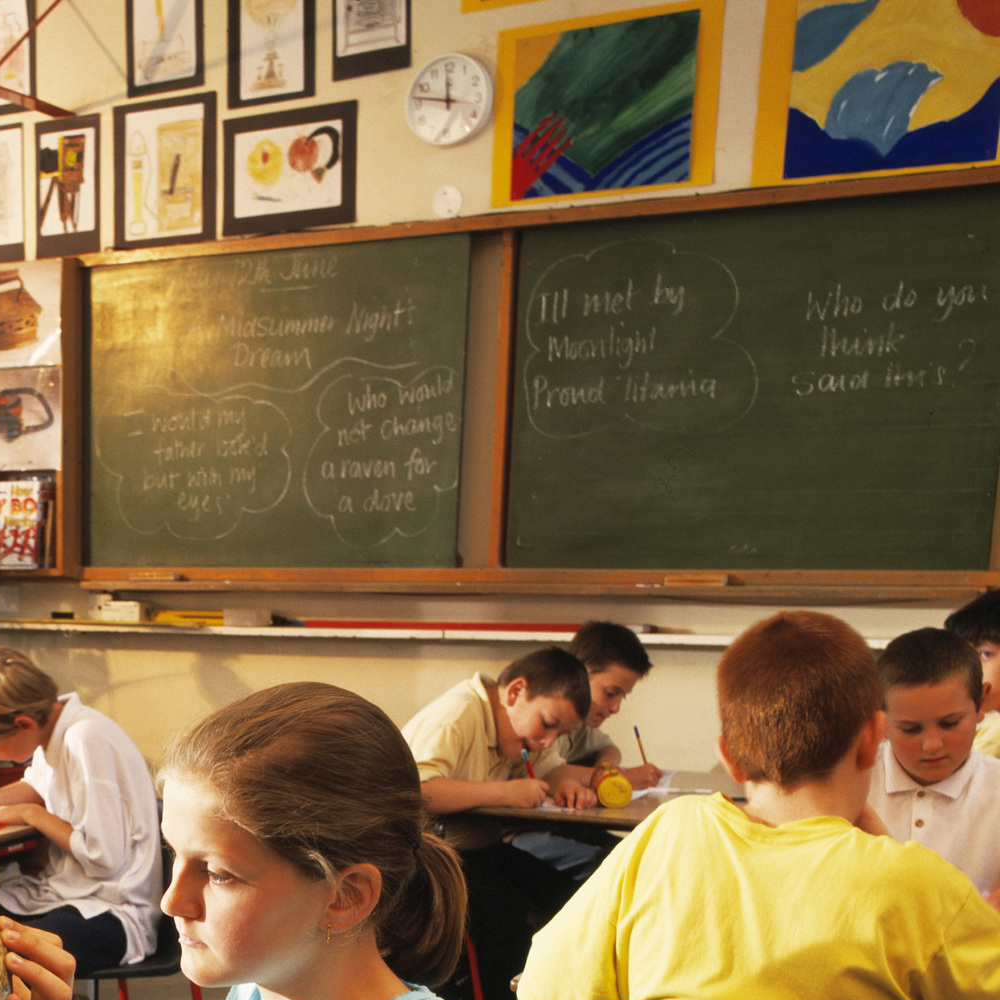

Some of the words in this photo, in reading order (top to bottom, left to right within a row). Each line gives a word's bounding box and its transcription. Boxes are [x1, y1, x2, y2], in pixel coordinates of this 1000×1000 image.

[583, 278, 637, 316] met
[652, 272, 686, 316] by
[806, 282, 864, 321] Who
[882, 280, 918, 312] do
[935, 282, 988, 324] you
[233, 343, 313, 369] Dream
[547, 321, 658, 370] Moonlight
[399, 373, 455, 405] would
[531, 374, 608, 412] Proud
[337, 419, 373, 447] not
[380, 412, 457, 446] change
[321, 460, 336, 480] a
[340, 457, 396, 478] raven
[403, 448, 437, 481] for
[10, 497, 38, 516] BO
[338, 493, 354, 513] a
[362, 489, 418, 514] dove
